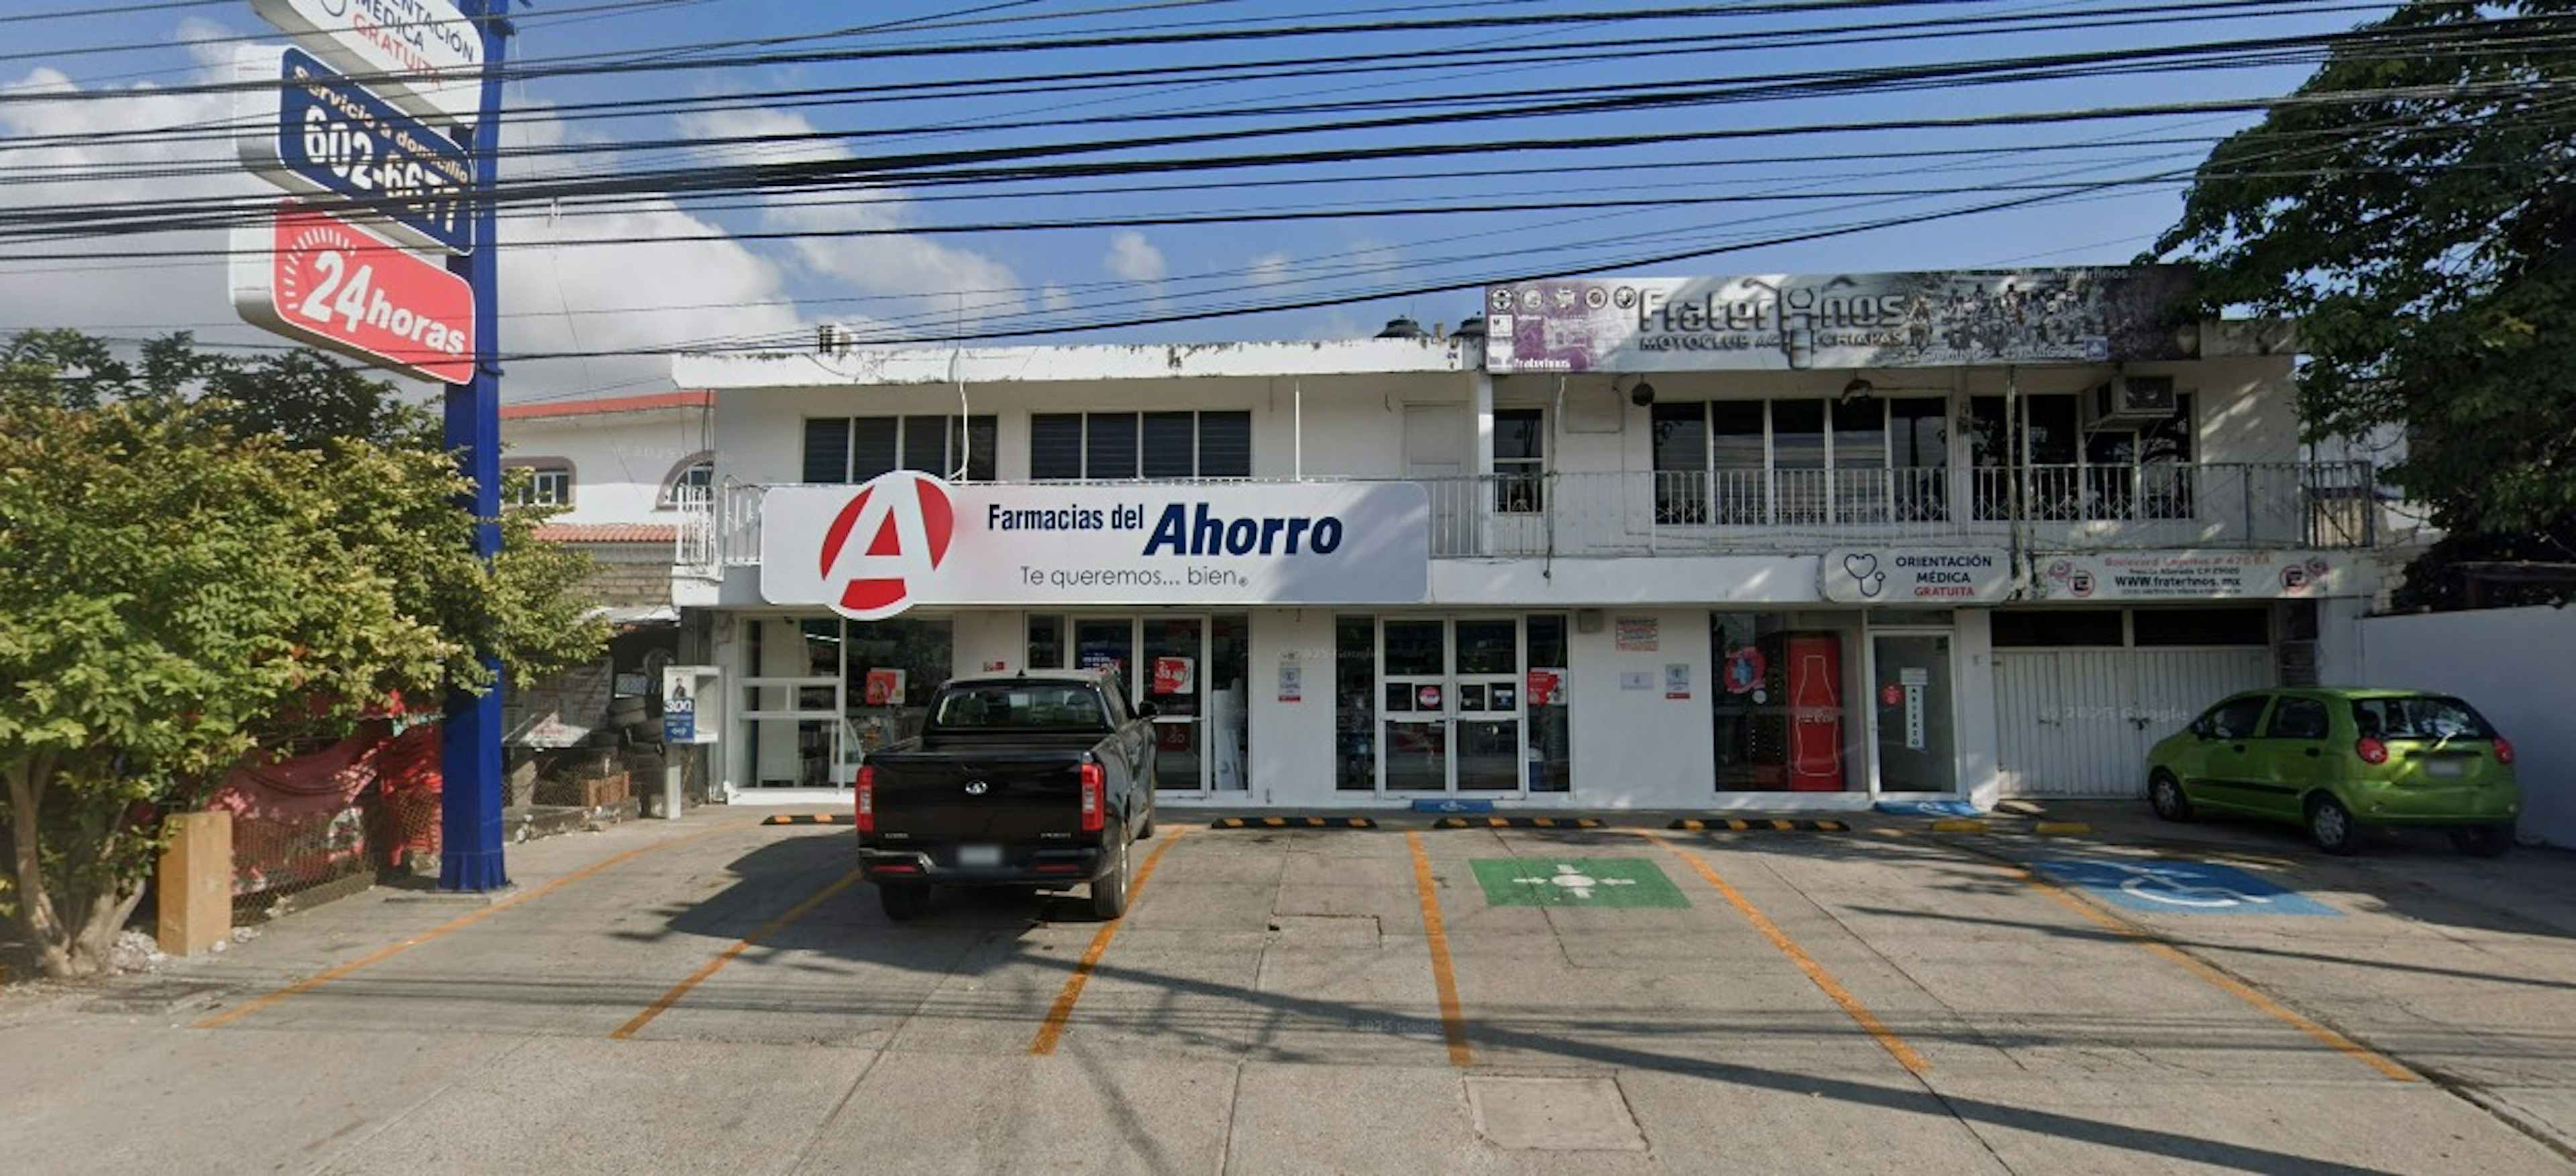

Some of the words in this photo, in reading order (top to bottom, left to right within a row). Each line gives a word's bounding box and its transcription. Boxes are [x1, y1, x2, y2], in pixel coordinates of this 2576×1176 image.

[301, 250, 374, 333] 24
[366, 297, 465, 356] horas
[1637, 335, 1748, 352] MOTOCLUB
[987, 503, 1104, 531] Farmacias
[1111, 502, 1143, 531] del
[1142, 502, 1343, 556] Ahorro
[1896, 555, 1992, 568] ORIENTACIÓN
[1020, 566, 1044, 586] Te
[1051, 569, 1181, 592] queremos...
[1916, 569, 1971, 584] MÉDICA
[1913, 586, 1976, 598] GRATUITA
